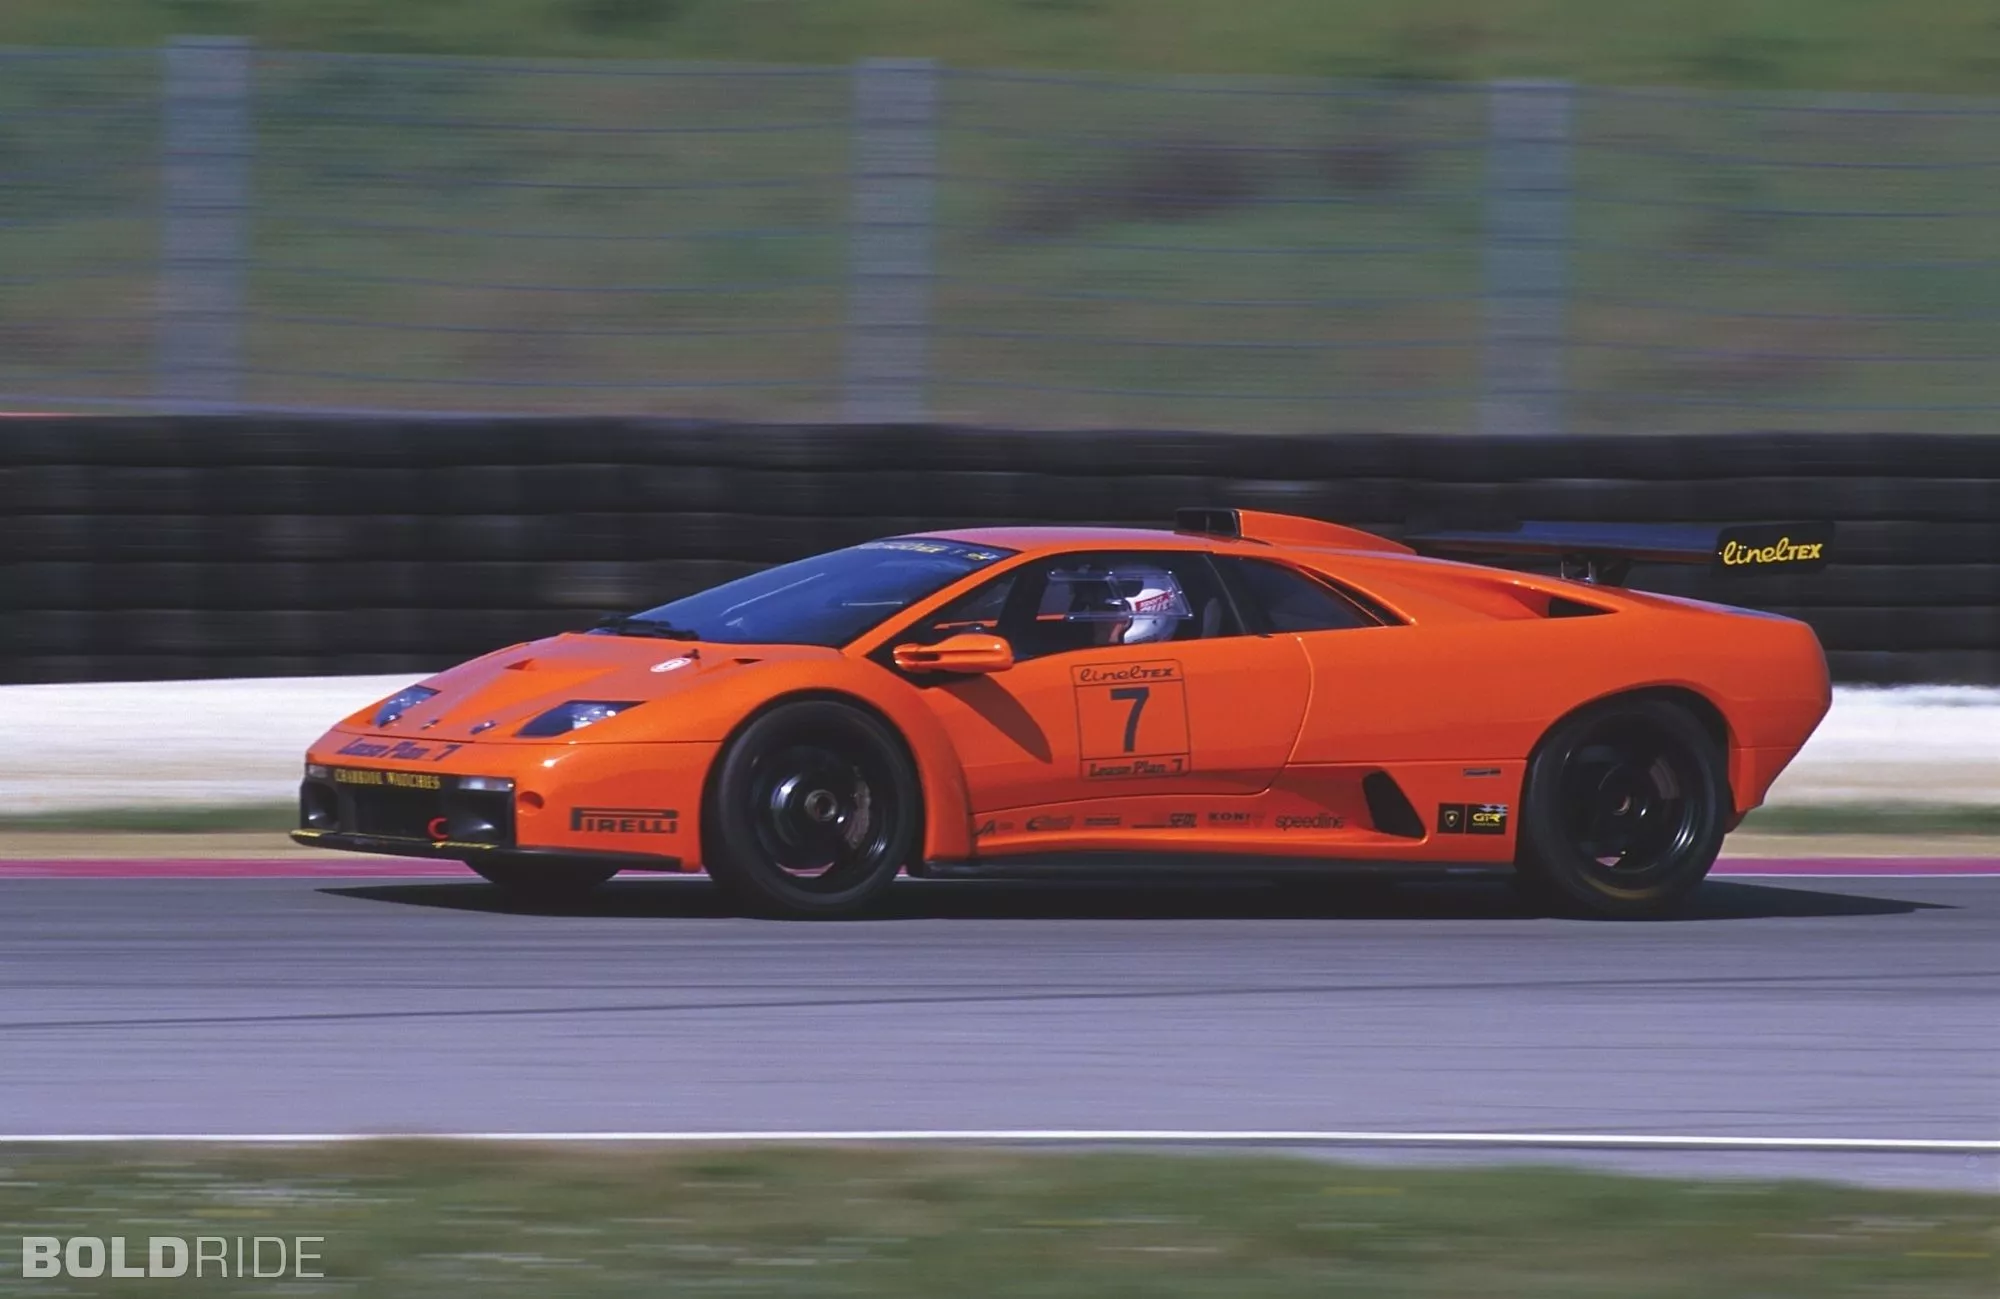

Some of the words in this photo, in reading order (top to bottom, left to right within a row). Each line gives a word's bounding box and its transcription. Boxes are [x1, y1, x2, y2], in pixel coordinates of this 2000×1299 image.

[1079, 665, 1174, 682] linelTEX
[1109, 686, 1150, 753] 7
[433, 744, 463, 761] 7
[1171, 758, 1183, 773] 7
[570, 807, 680, 834] PIRELLI
[1275, 812, 1345, 830] speedline
[1472, 812, 1501, 823] GTR
